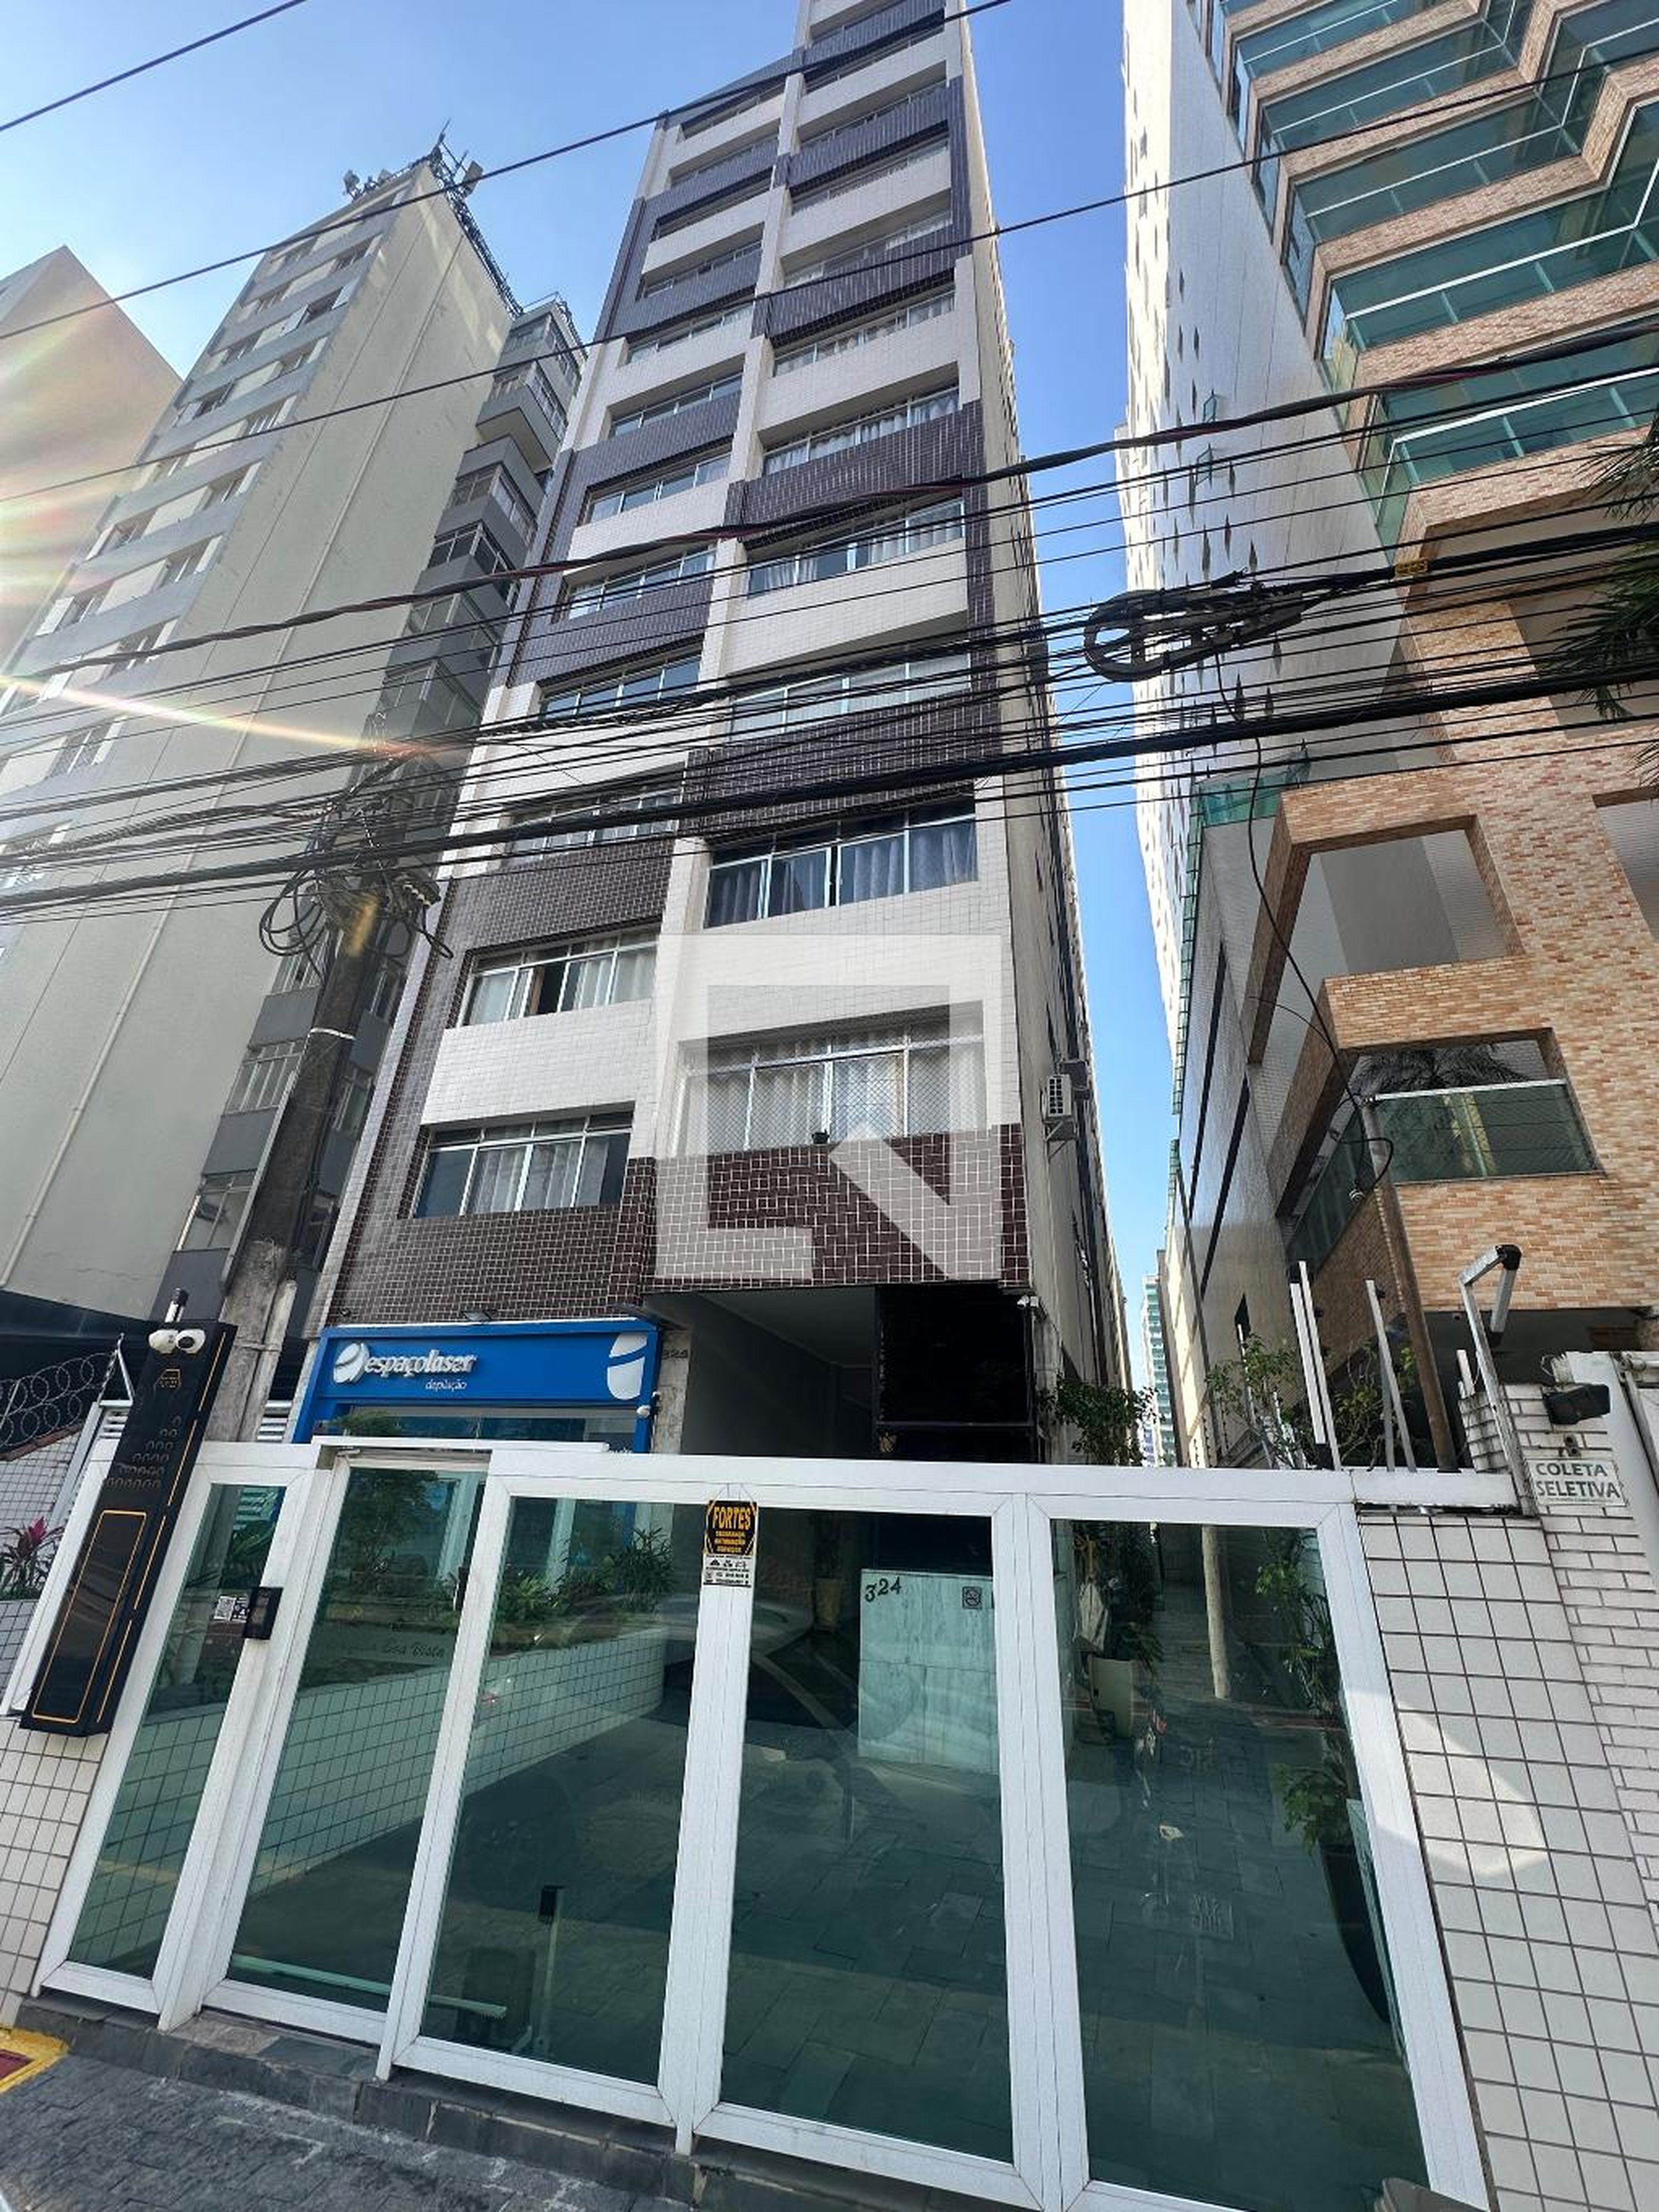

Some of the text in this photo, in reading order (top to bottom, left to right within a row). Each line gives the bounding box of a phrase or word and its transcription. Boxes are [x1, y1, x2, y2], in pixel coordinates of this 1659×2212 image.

[364, 1349, 477, 1378] espaçolaser
[425, 1378, 467, 1392] depilação
[1536, 1463, 1608, 1477] COLETA
[1536, 1480, 1621, 1498] SELETIVA
[713, 1506, 751, 1530] FORTES
[864, 1576, 902, 1602] 324
